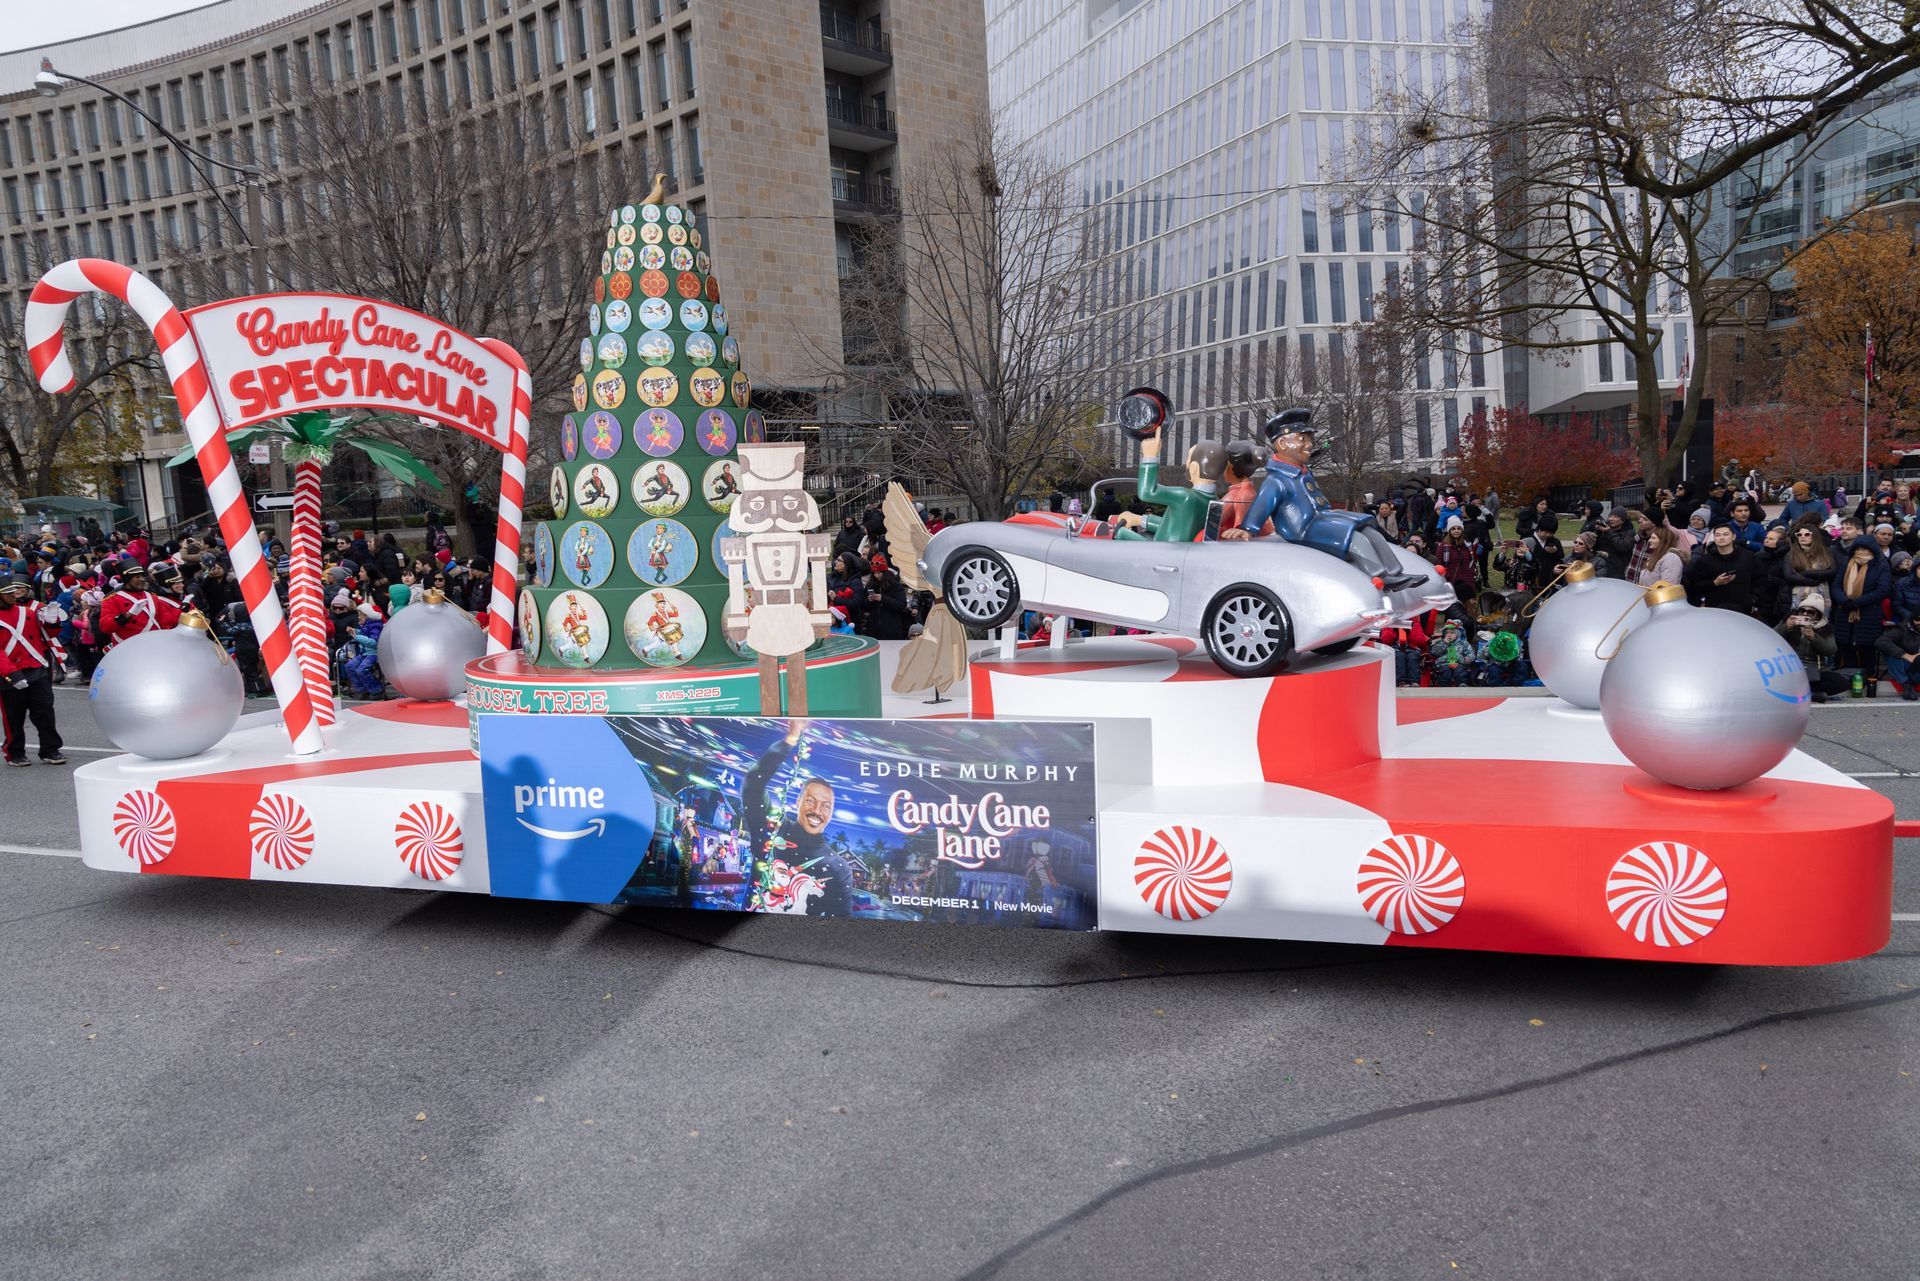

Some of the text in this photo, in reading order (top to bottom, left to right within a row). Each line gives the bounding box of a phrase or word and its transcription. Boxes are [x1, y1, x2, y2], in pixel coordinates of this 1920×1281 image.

[236, 304, 487, 386] Candy Cane Lane
[229, 355, 498, 436] SPECTACULAR
[534, 689, 609, 714] TREE
[656, 687, 721, 701] XMS-1225
[860, 761, 1078, 782] EDDIE MURPHY
[514, 777, 604, 813] prime
[887, 789, 1050, 837] Candy Cane
[936, 826, 1001, 869] Lane
[892, 895, 1053, 914] DECEMBER 1 New Movie
